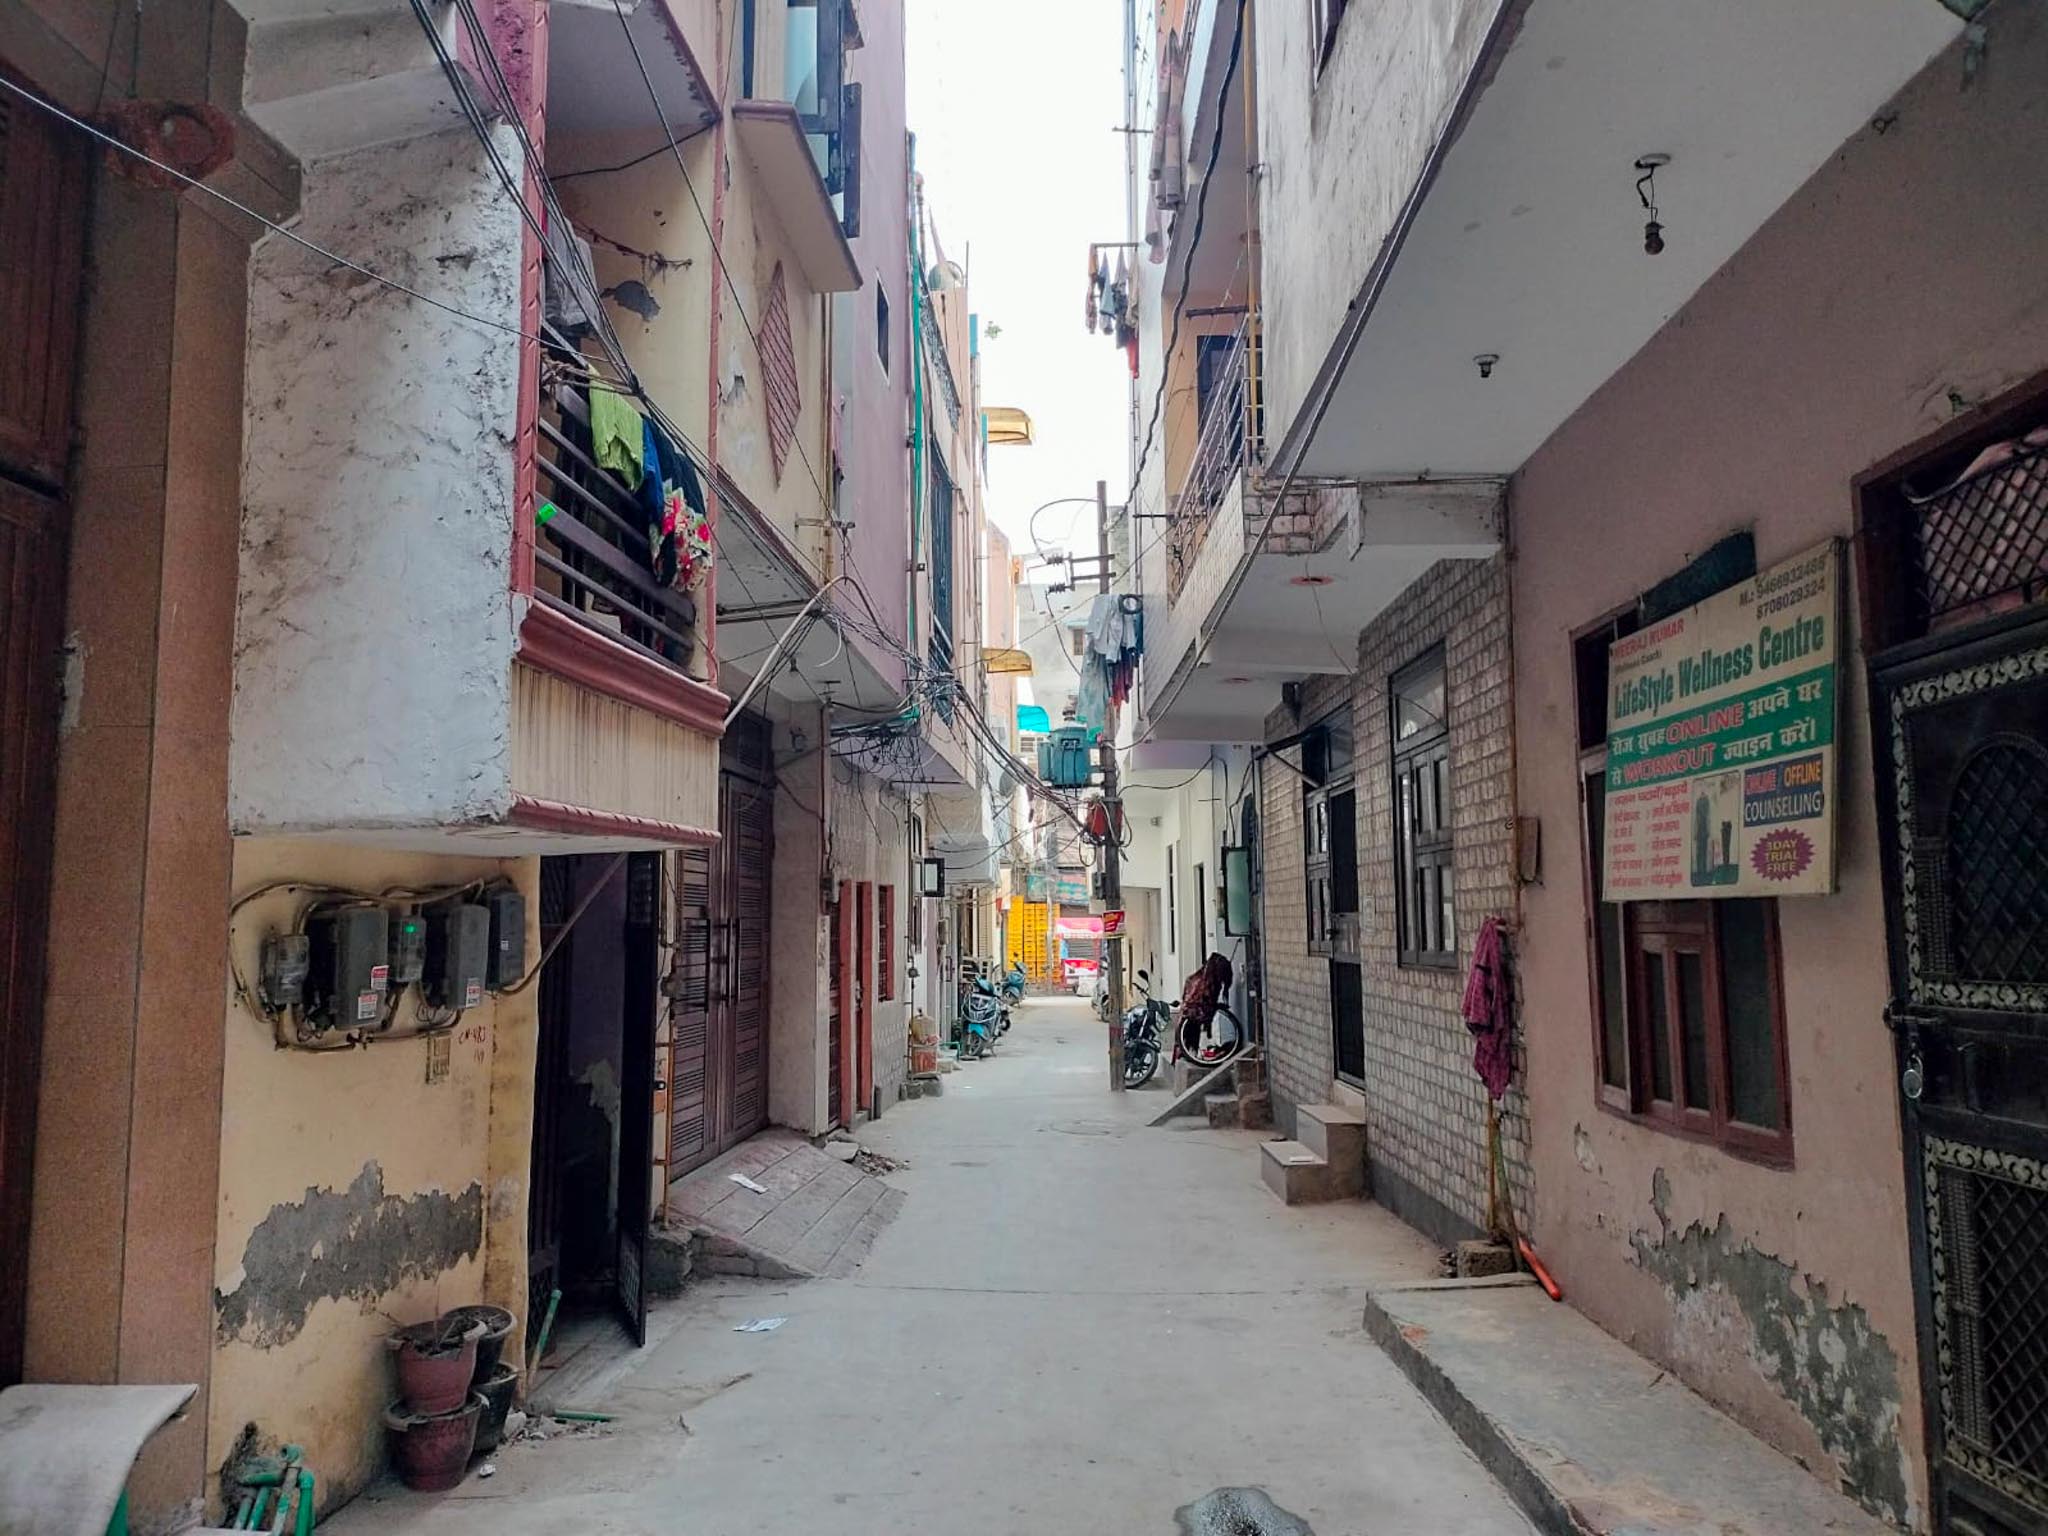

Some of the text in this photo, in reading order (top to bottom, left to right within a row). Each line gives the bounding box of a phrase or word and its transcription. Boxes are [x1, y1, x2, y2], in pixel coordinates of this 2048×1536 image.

[1649, 618, 1685, 647] KUMAR
[1614, 615, 1824, 720] LifeStyle Wellness Centre
[1612, 737, 1634, 756] रोज
[1665, 702, 1745, 743] ONLINE
[1747, 686, 1791, 720] अपने
[1797, 679, 1823, 702] घर
[1623, 742, 1716, 784] WORKOUT
[1784, 761, 1821, 787] OFFLINE
[1745, 790, 1821, 821] COUNSELLING
[1767, 850, 1797, 862] TRIAL
[1768, 861, 1797, 873] FREE
